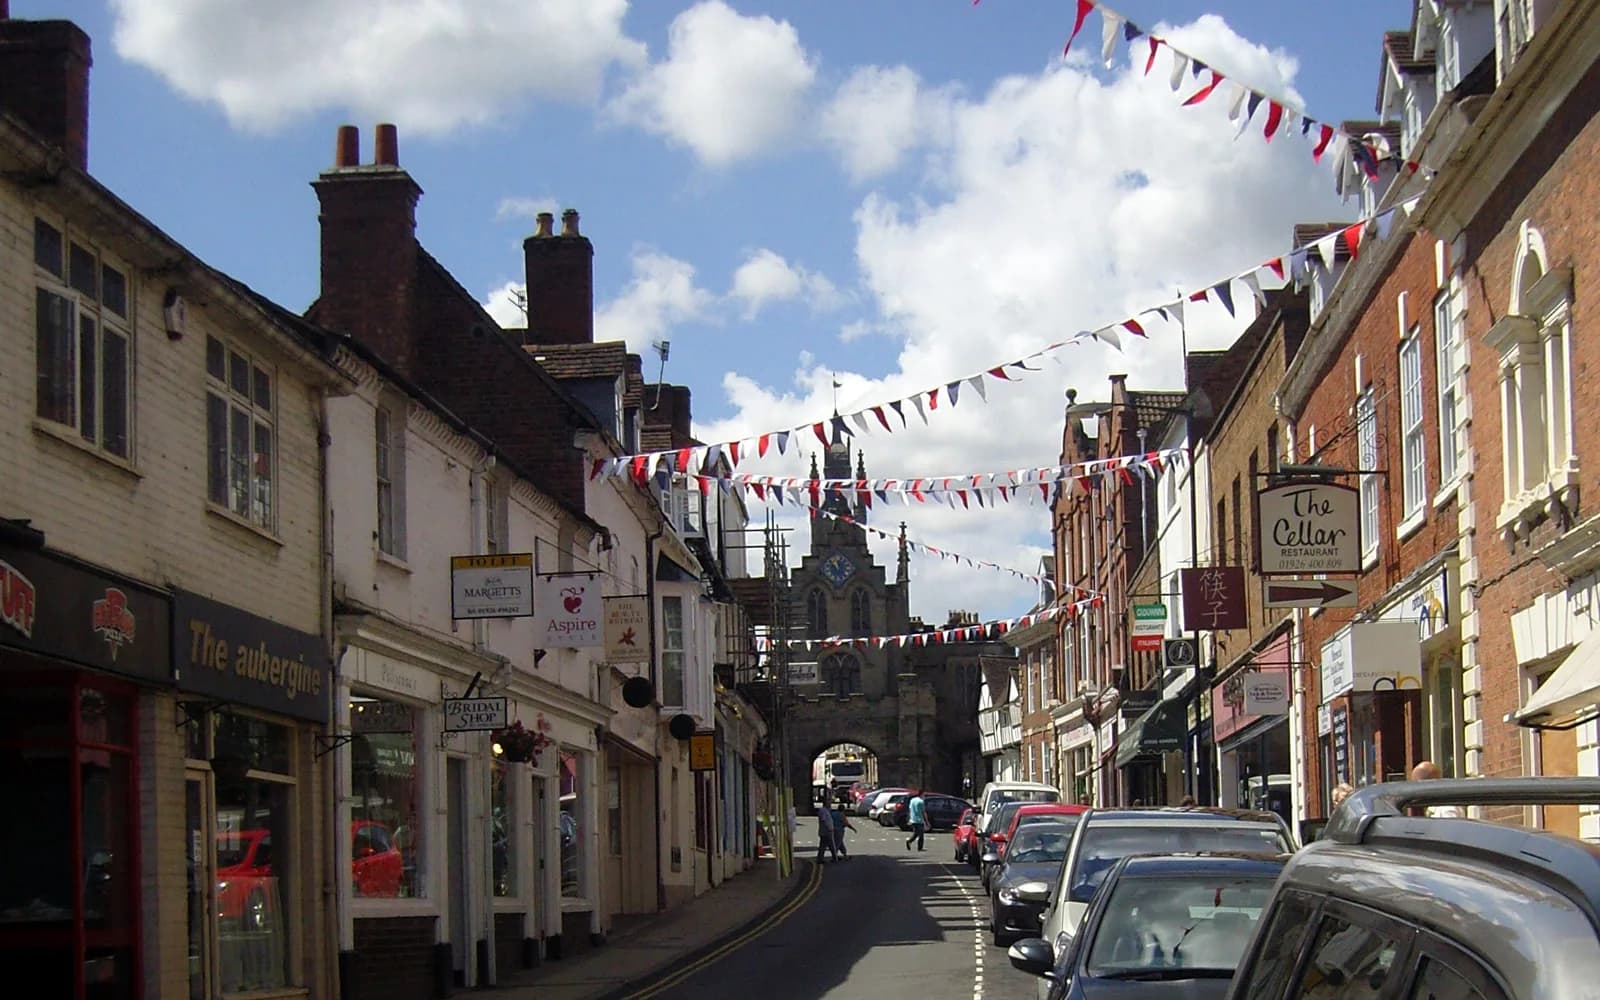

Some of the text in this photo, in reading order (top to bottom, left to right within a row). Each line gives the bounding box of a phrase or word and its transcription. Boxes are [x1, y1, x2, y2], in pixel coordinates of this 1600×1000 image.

[1282, 488, 1334, 517] The
[1273, 518, 1346, 547] Cellar
[1281, 548, 1339, 557] RESTAURANT
[468, 558, 487, 567] TO
[1279, 559, 1306, 570] 01926
[464, 586, 522, 600] MARGETTS
[1200, 569, 1229, 628] 筷子
[547, 617, 597, 634] Aspire
[190, 620, 228, 671] The
[235, 641, 321, 700] aubergine
[448, 701, 503, 716] BRIDAL
[456, 712, 497, 729] SHOP
